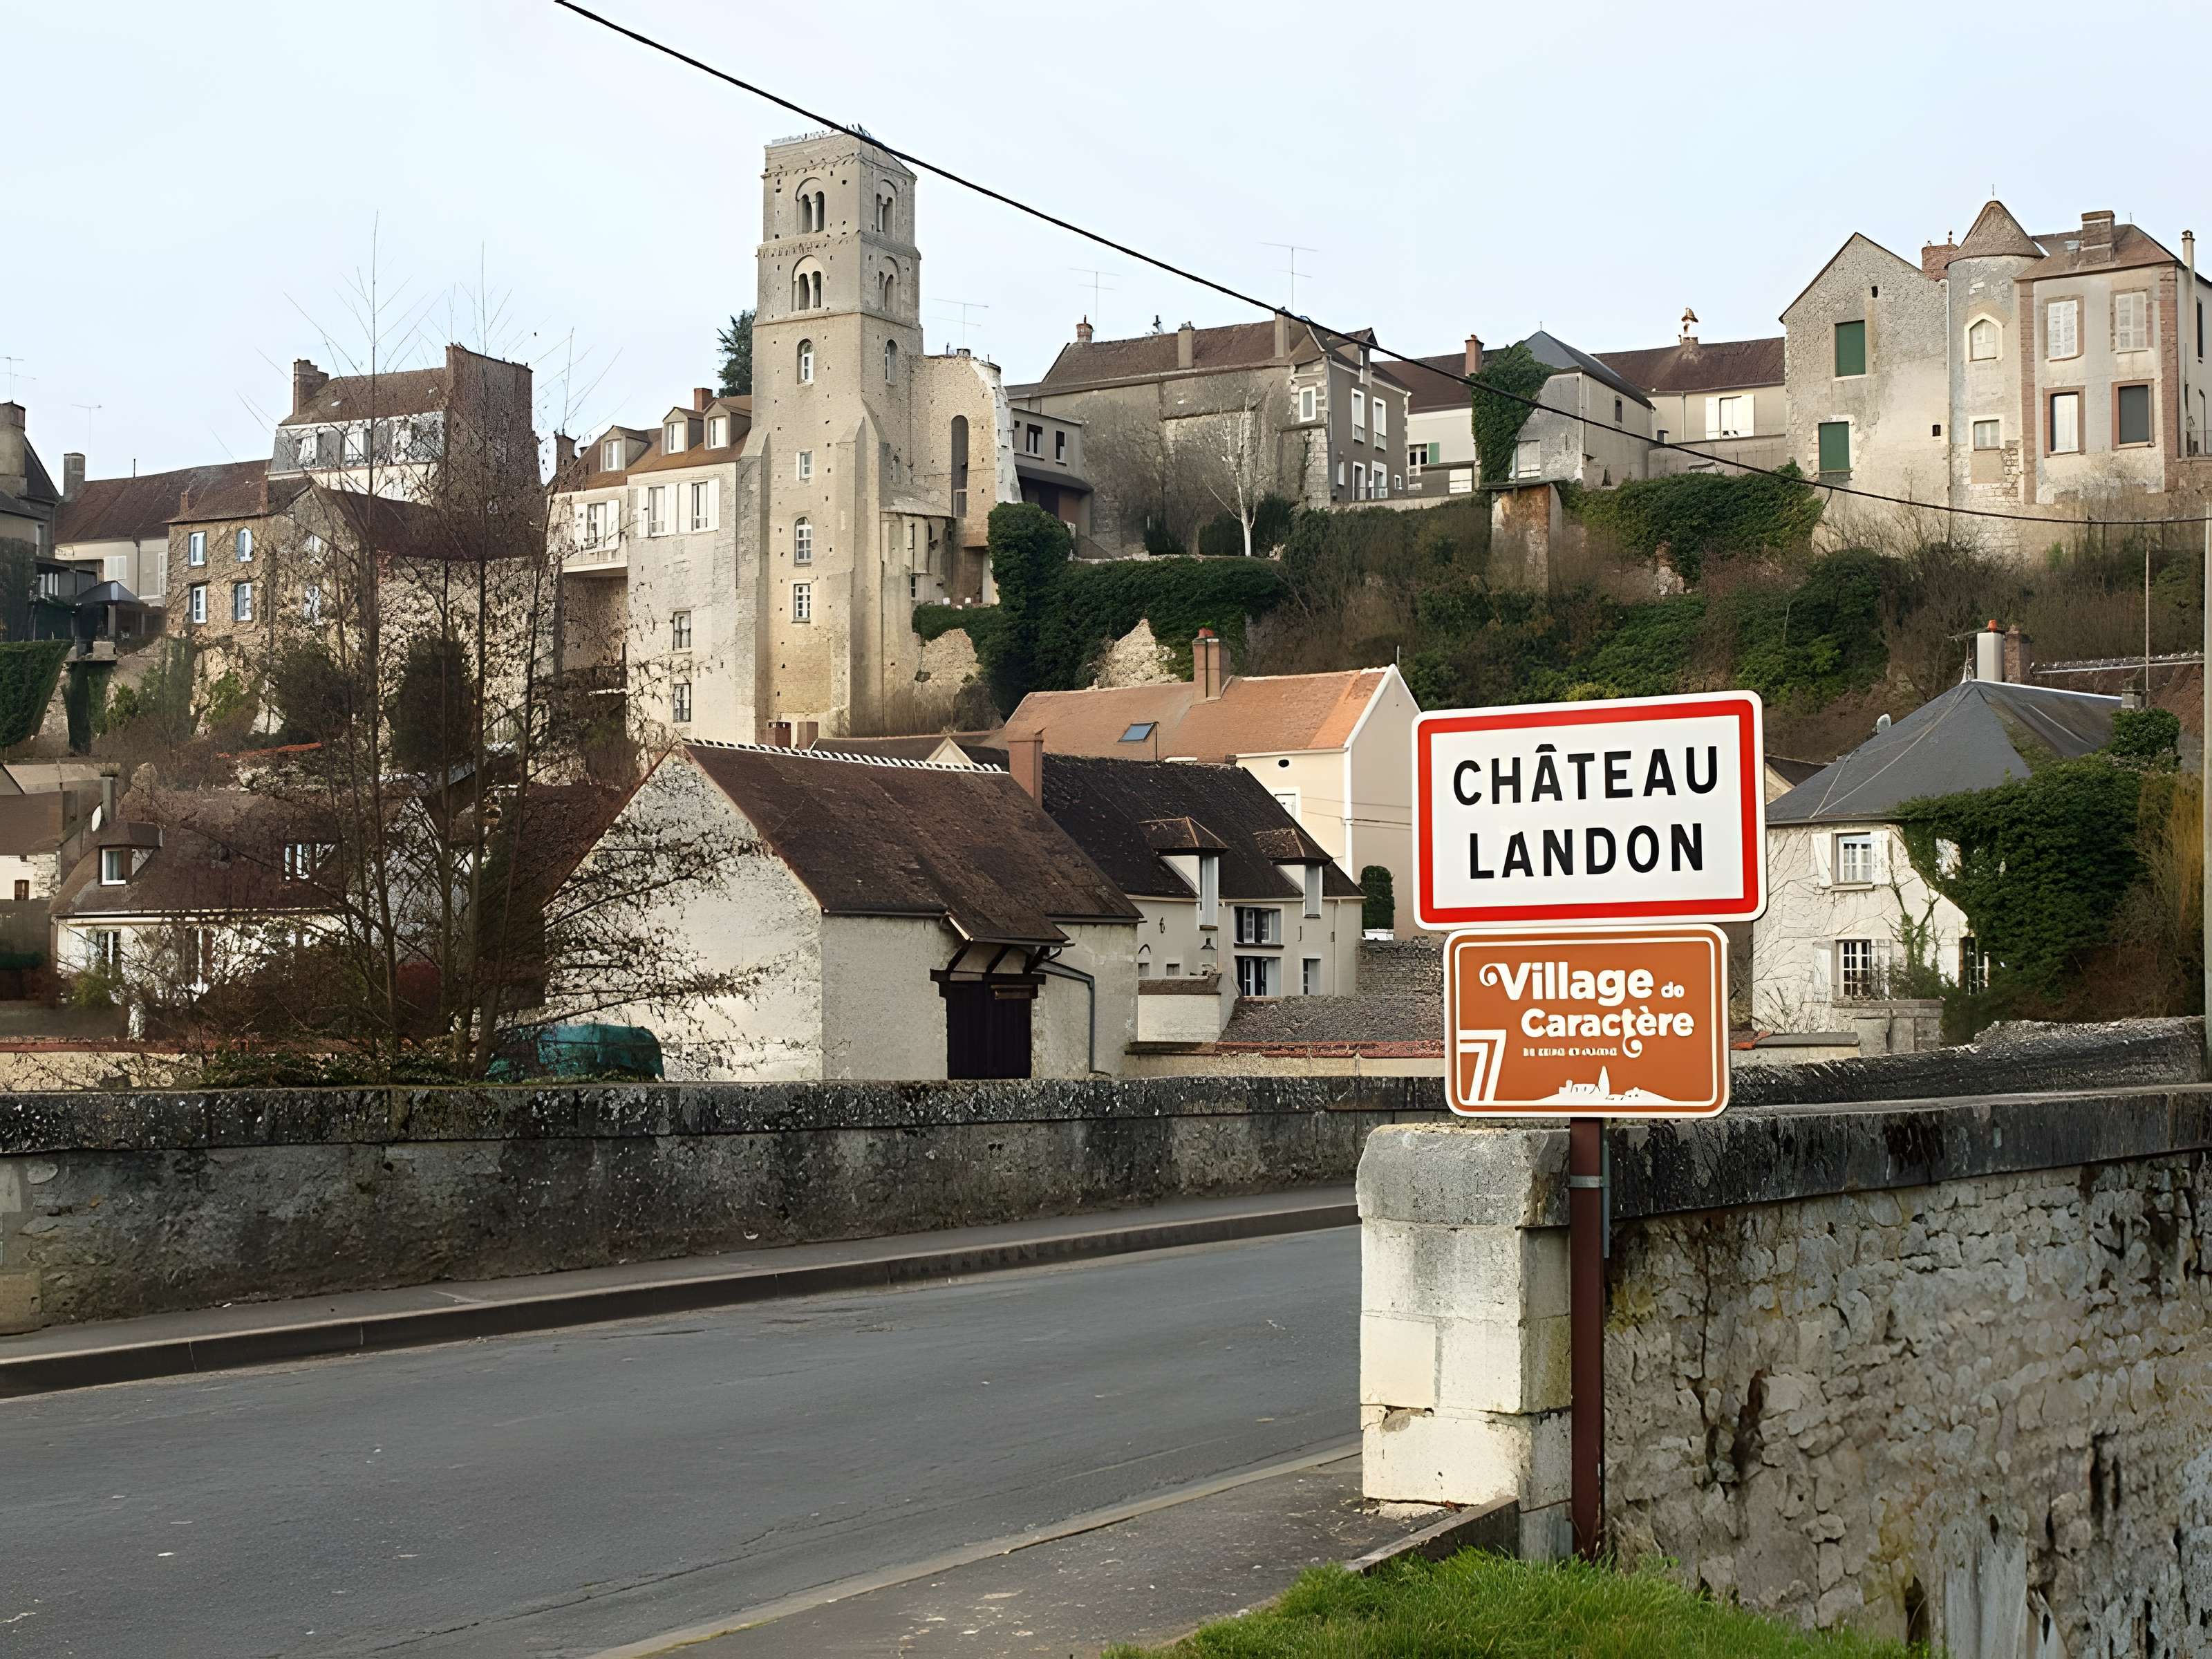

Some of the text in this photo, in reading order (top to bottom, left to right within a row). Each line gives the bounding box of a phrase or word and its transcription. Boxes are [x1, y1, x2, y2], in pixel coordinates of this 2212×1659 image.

[1453, 744, 1717, 806] CHÂTEAU
[1470, 823, 1703, 879] LANDON
[1479, 962, 1654, 1006] Village
[1521, 1006, 1695, 1058] Caractère
